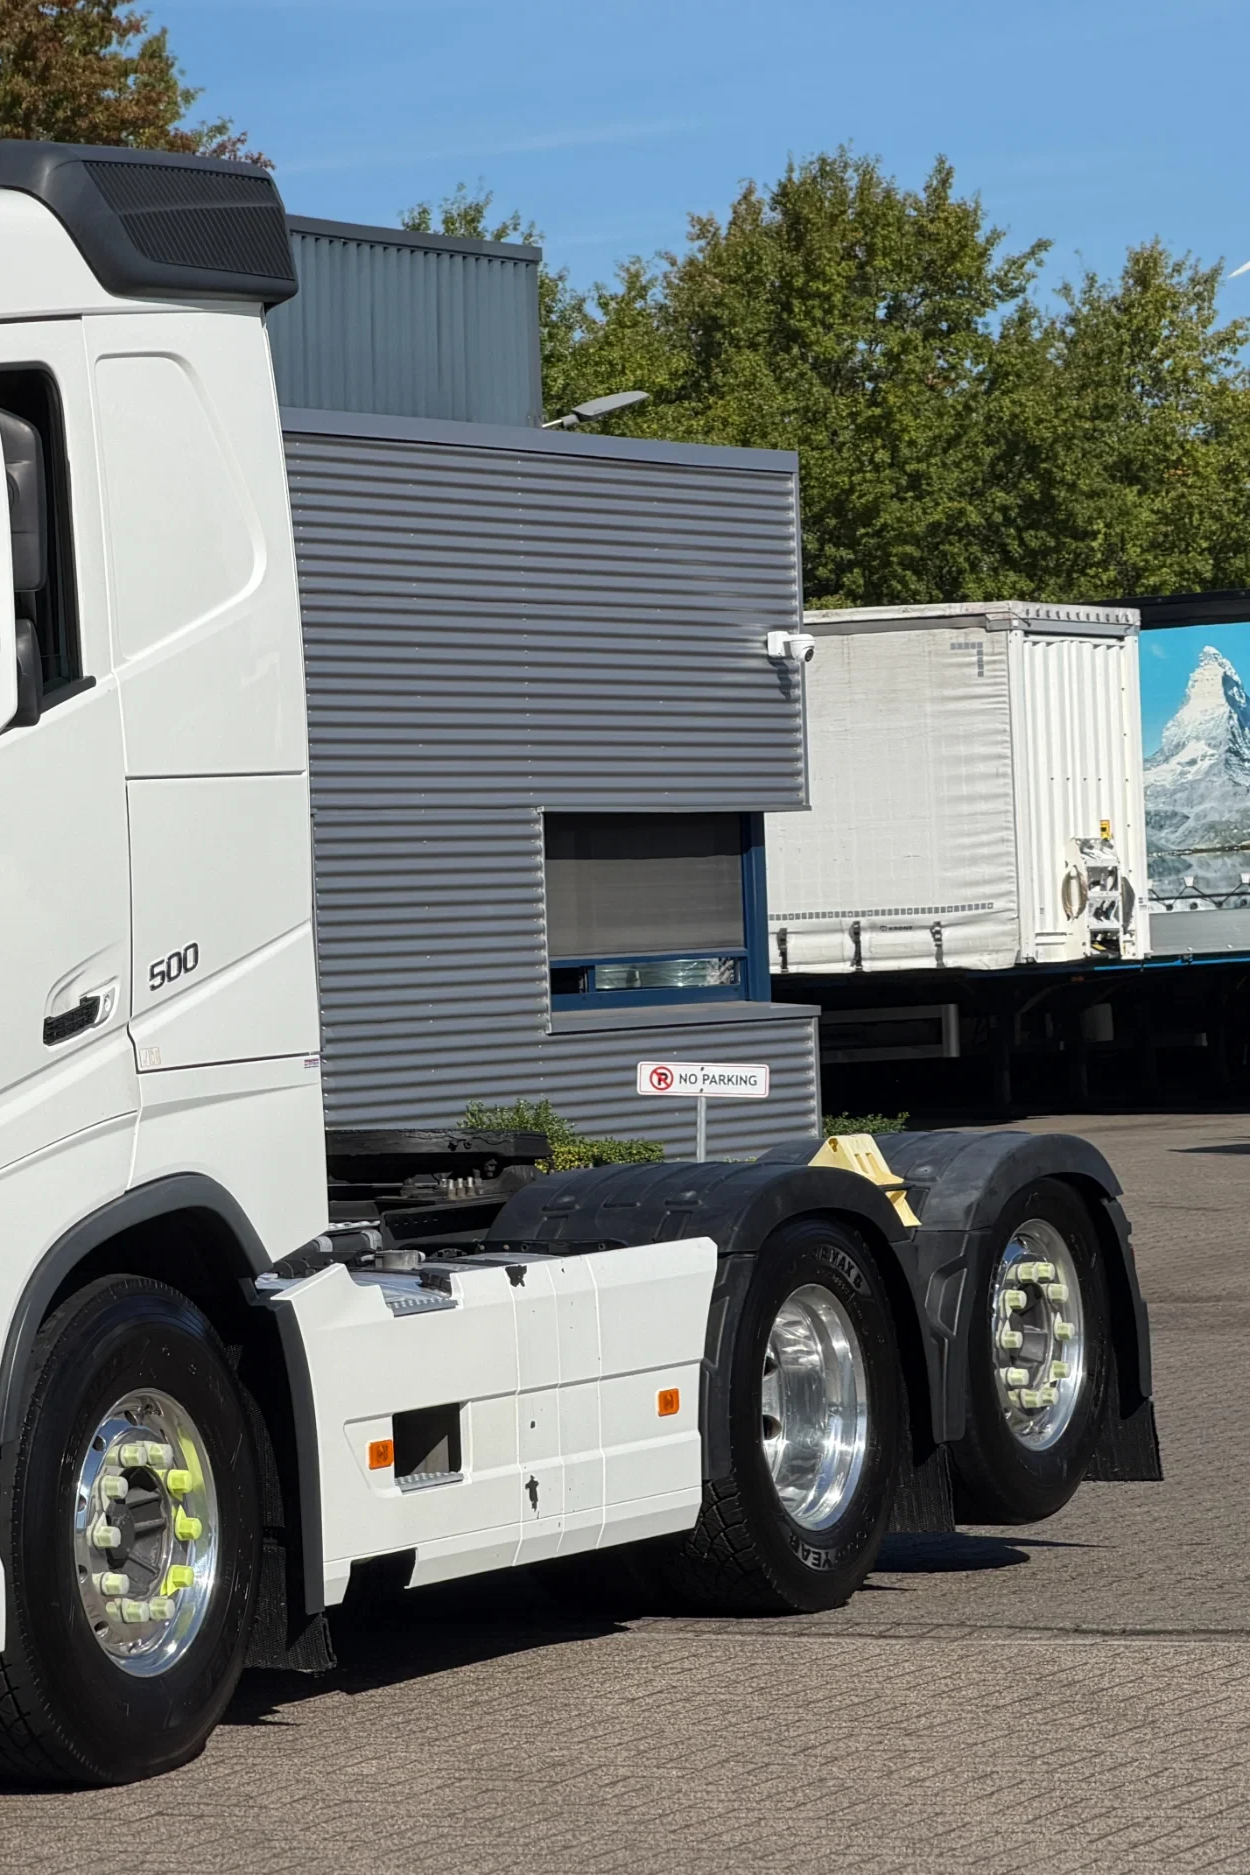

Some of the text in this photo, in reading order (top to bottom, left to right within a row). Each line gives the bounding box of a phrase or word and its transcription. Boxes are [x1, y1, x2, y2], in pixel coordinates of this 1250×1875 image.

[149, 942, 199, 991] 500
[679, 1073, 757, 1086] NO PARKING
